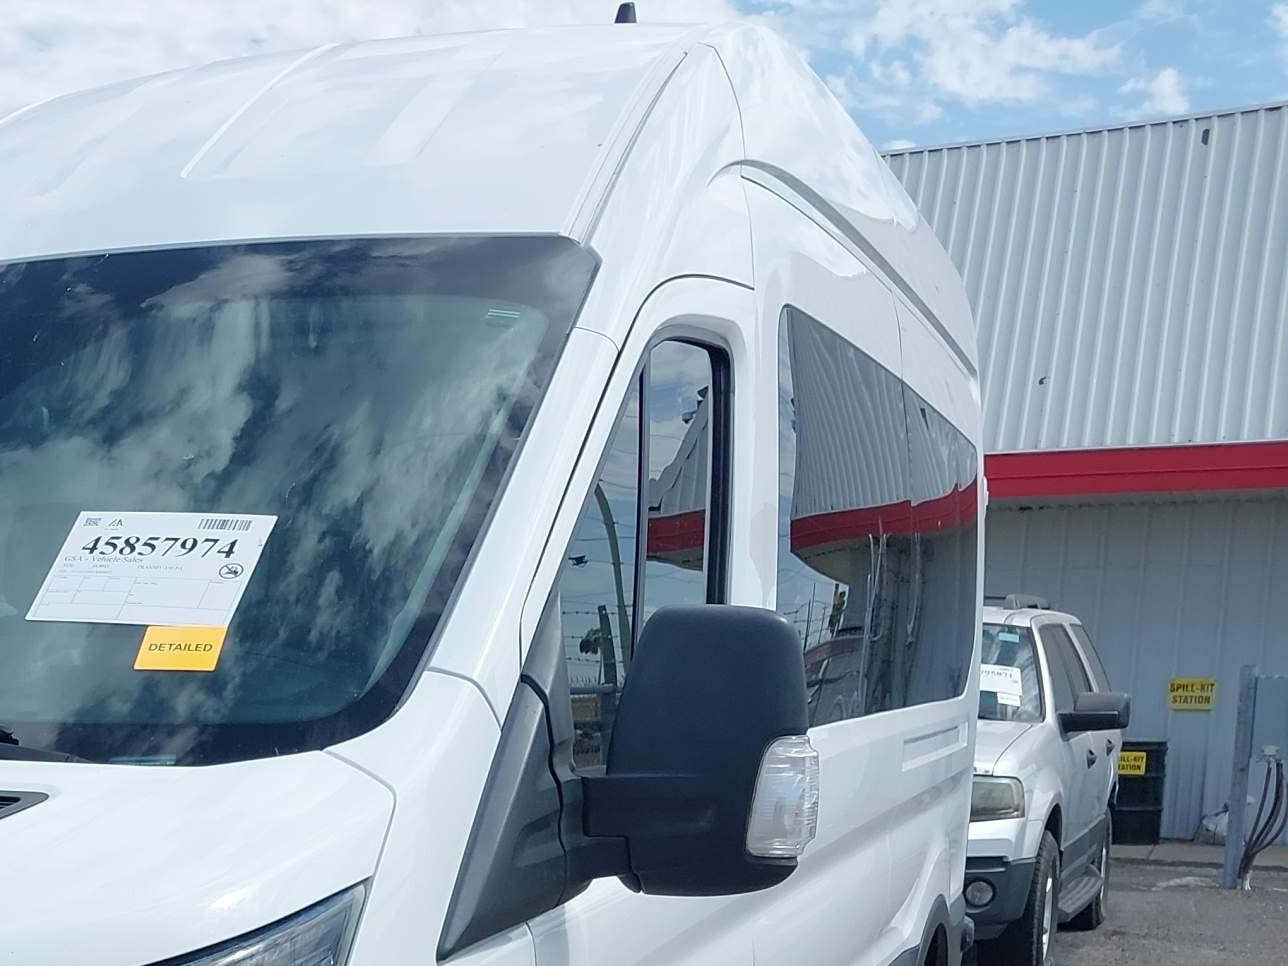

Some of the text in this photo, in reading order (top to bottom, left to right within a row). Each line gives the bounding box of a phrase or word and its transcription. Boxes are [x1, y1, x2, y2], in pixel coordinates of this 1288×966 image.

[81, 536, 238, 558] 45857974
[148, 643, 213, 652] DETAILED
[1170, 683, 1215, 693] SPILL-KIT
[1172, 695, 1211, 704] STATION
